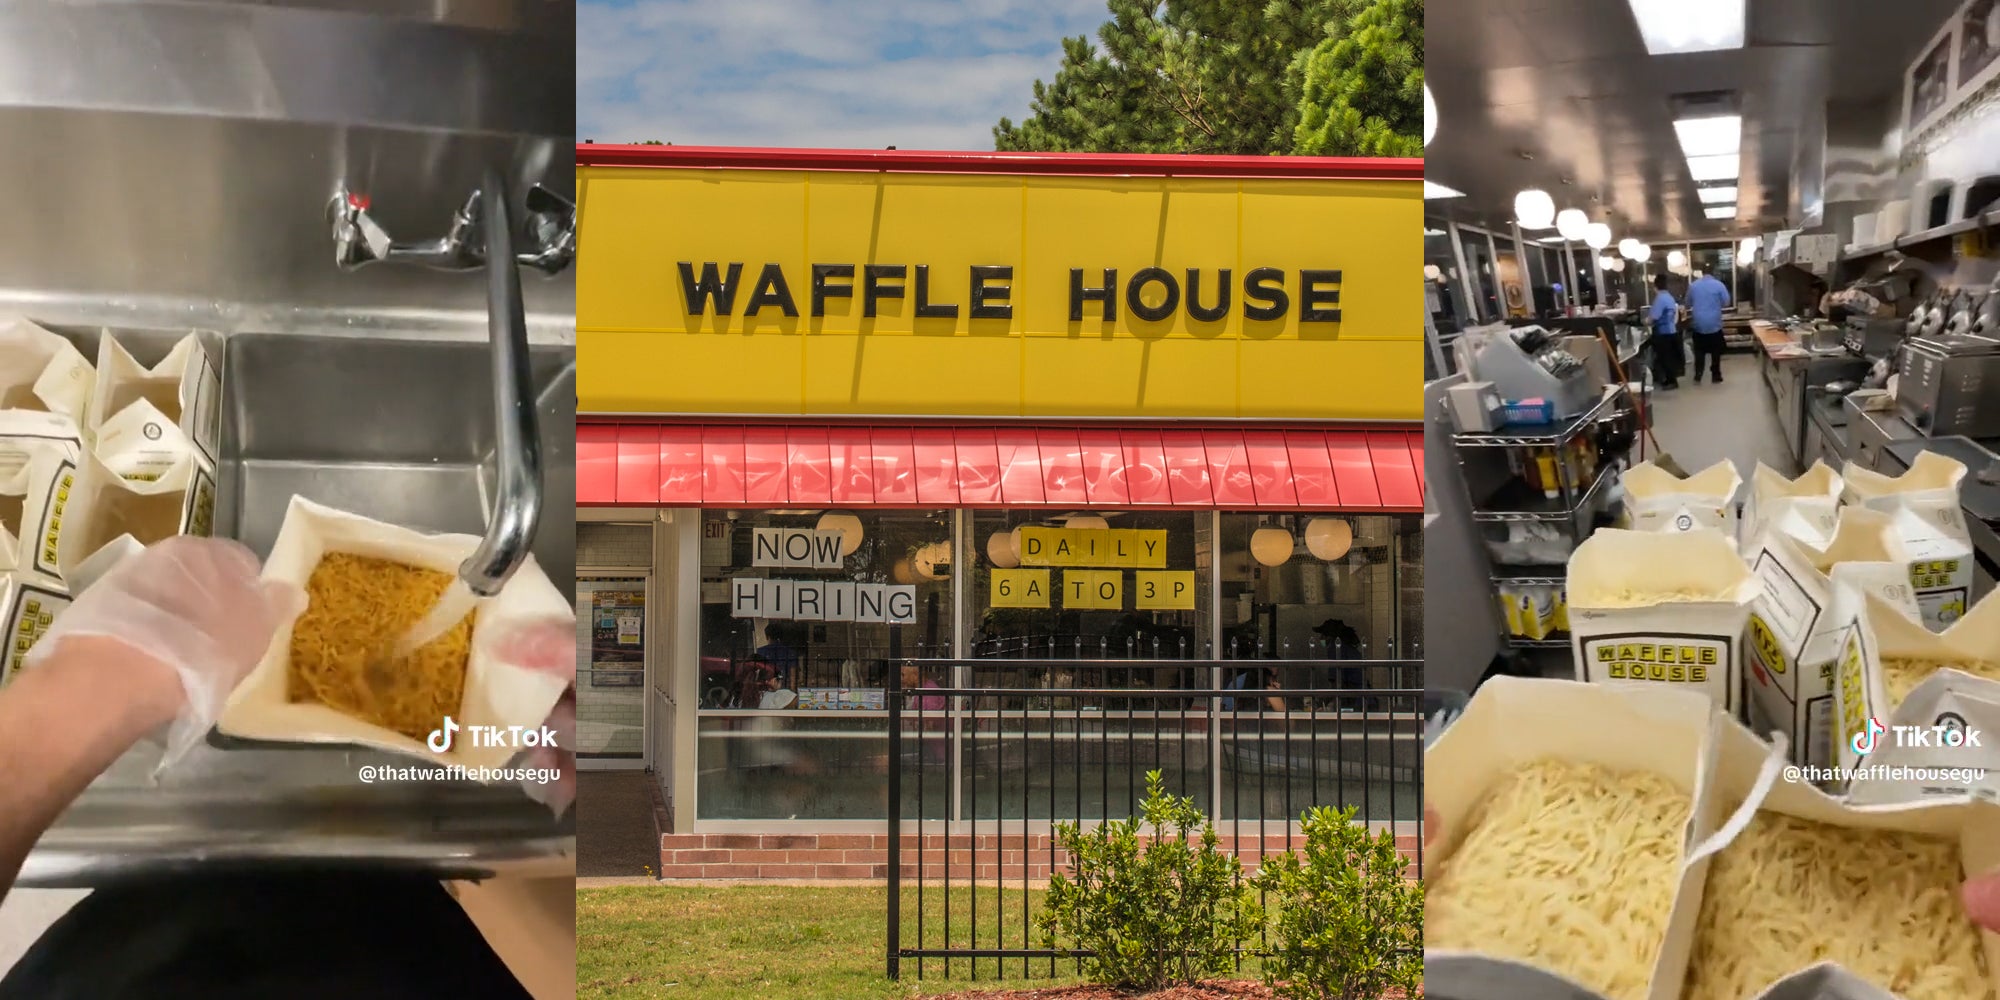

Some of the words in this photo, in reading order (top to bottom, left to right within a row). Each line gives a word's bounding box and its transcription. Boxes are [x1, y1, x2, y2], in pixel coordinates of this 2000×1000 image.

[677, 261, 1013, 319] WAFFLE
[1069, 266, 1342, 322] HOUSE
[44, 474, 73, 565] WAFFLE
[705, 522, 725, 538] EXIT
[757, 533, 841, 563] NOW
[1028, 538, 1156, 557] DAILY
[999, 579, 1041, 598] 6A
[1072, 581, 1115, 600] TO
[1145, 581, 1185, 599] 3P
[737, 584, 914, 618] HIRING
[1598, 644, 1716, 664] WAFFLE
[1610, 663, 1706, 681] HOUSE
